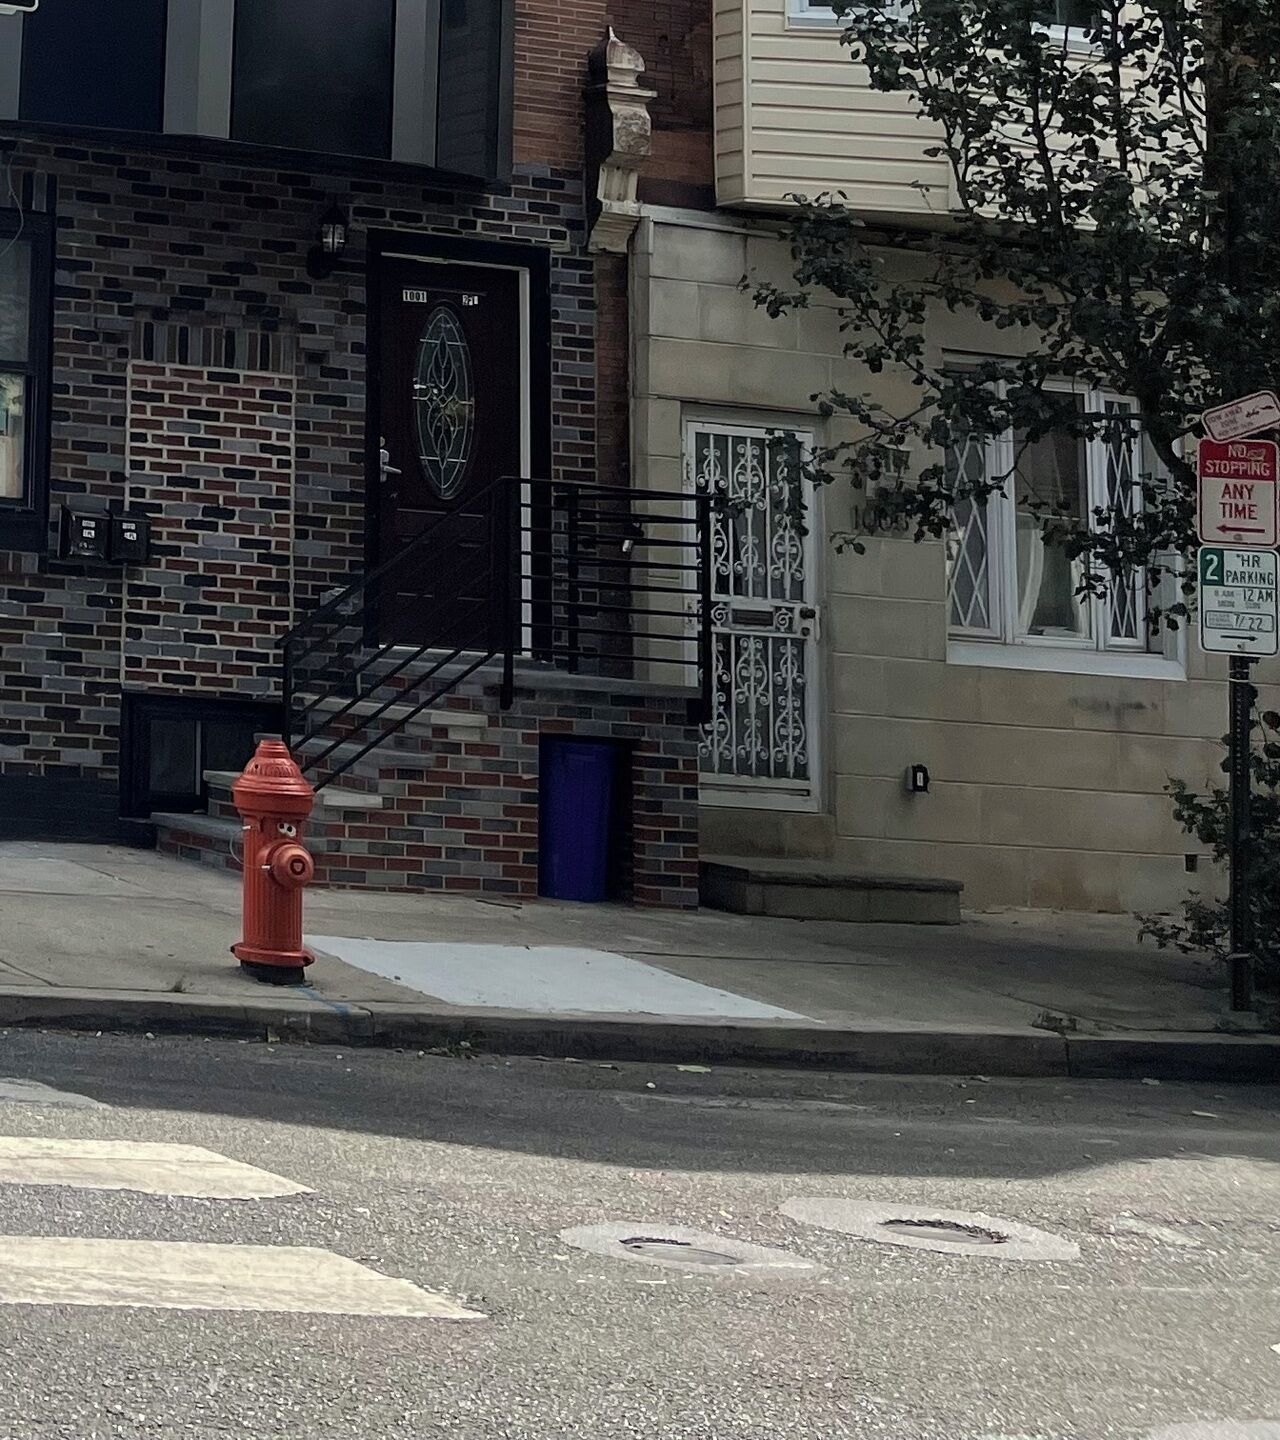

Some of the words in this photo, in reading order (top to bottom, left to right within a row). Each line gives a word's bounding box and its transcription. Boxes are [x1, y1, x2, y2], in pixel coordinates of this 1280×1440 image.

[403, 290, 427, 302] 1001
[1228, 444, 1247, 458] NO
[1205, 459, 1271, 476] STOPPING
[1221, 482, 1255, 500] ANY
[1219, 502, 1258, 520] TIME
[1204, 554, 1219, 581] 2
[1240, 554, 1261, 568] HR
[1225, 570, 1274, 586] PARKING
[1243, 588, 1254, 602] 12
[1257, 590, 1274, 603] AM
